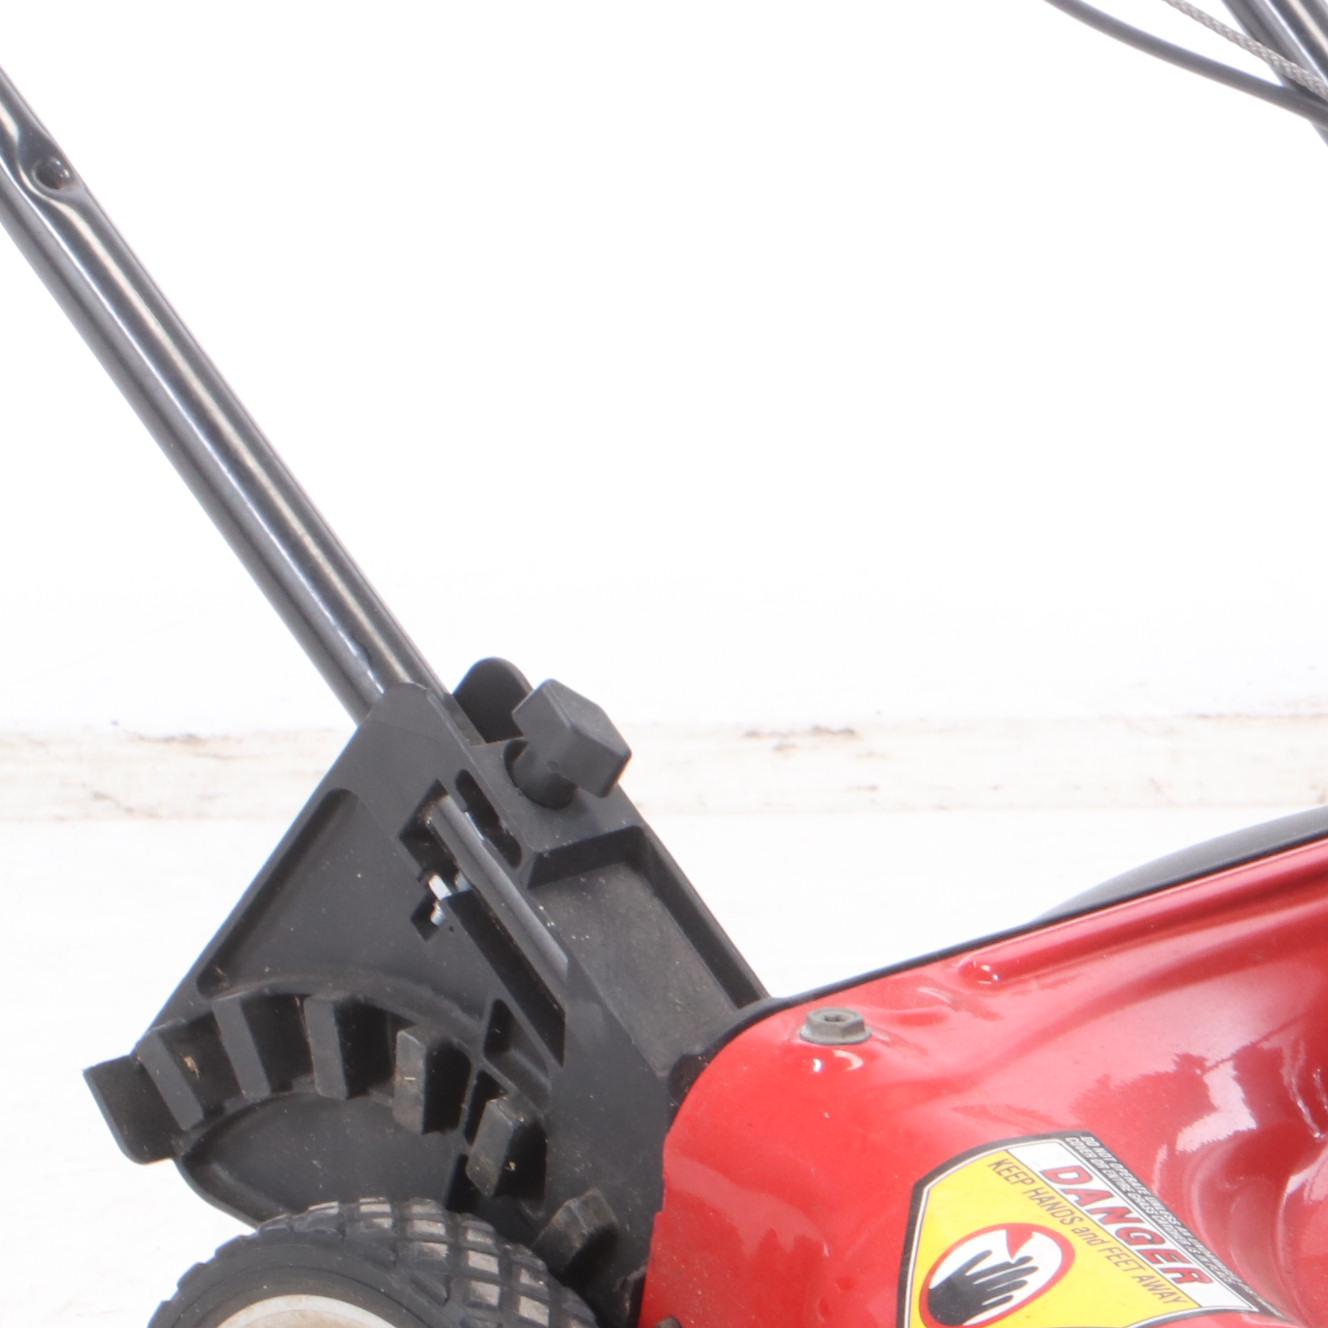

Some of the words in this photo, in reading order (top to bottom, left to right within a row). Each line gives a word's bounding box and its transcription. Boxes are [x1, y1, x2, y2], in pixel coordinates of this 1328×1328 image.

[988, 1158, 1034, 1190] KEEP
[1022, 1185, 1081, 1226] HANDS
[1070, 1224, 1103, 1248] and
[1097, 1238, 1146, 1275] FEET
[1135, 1272, 1189, 1305] AWAY
[1039, 1164, 1214, 1287] DANGER
